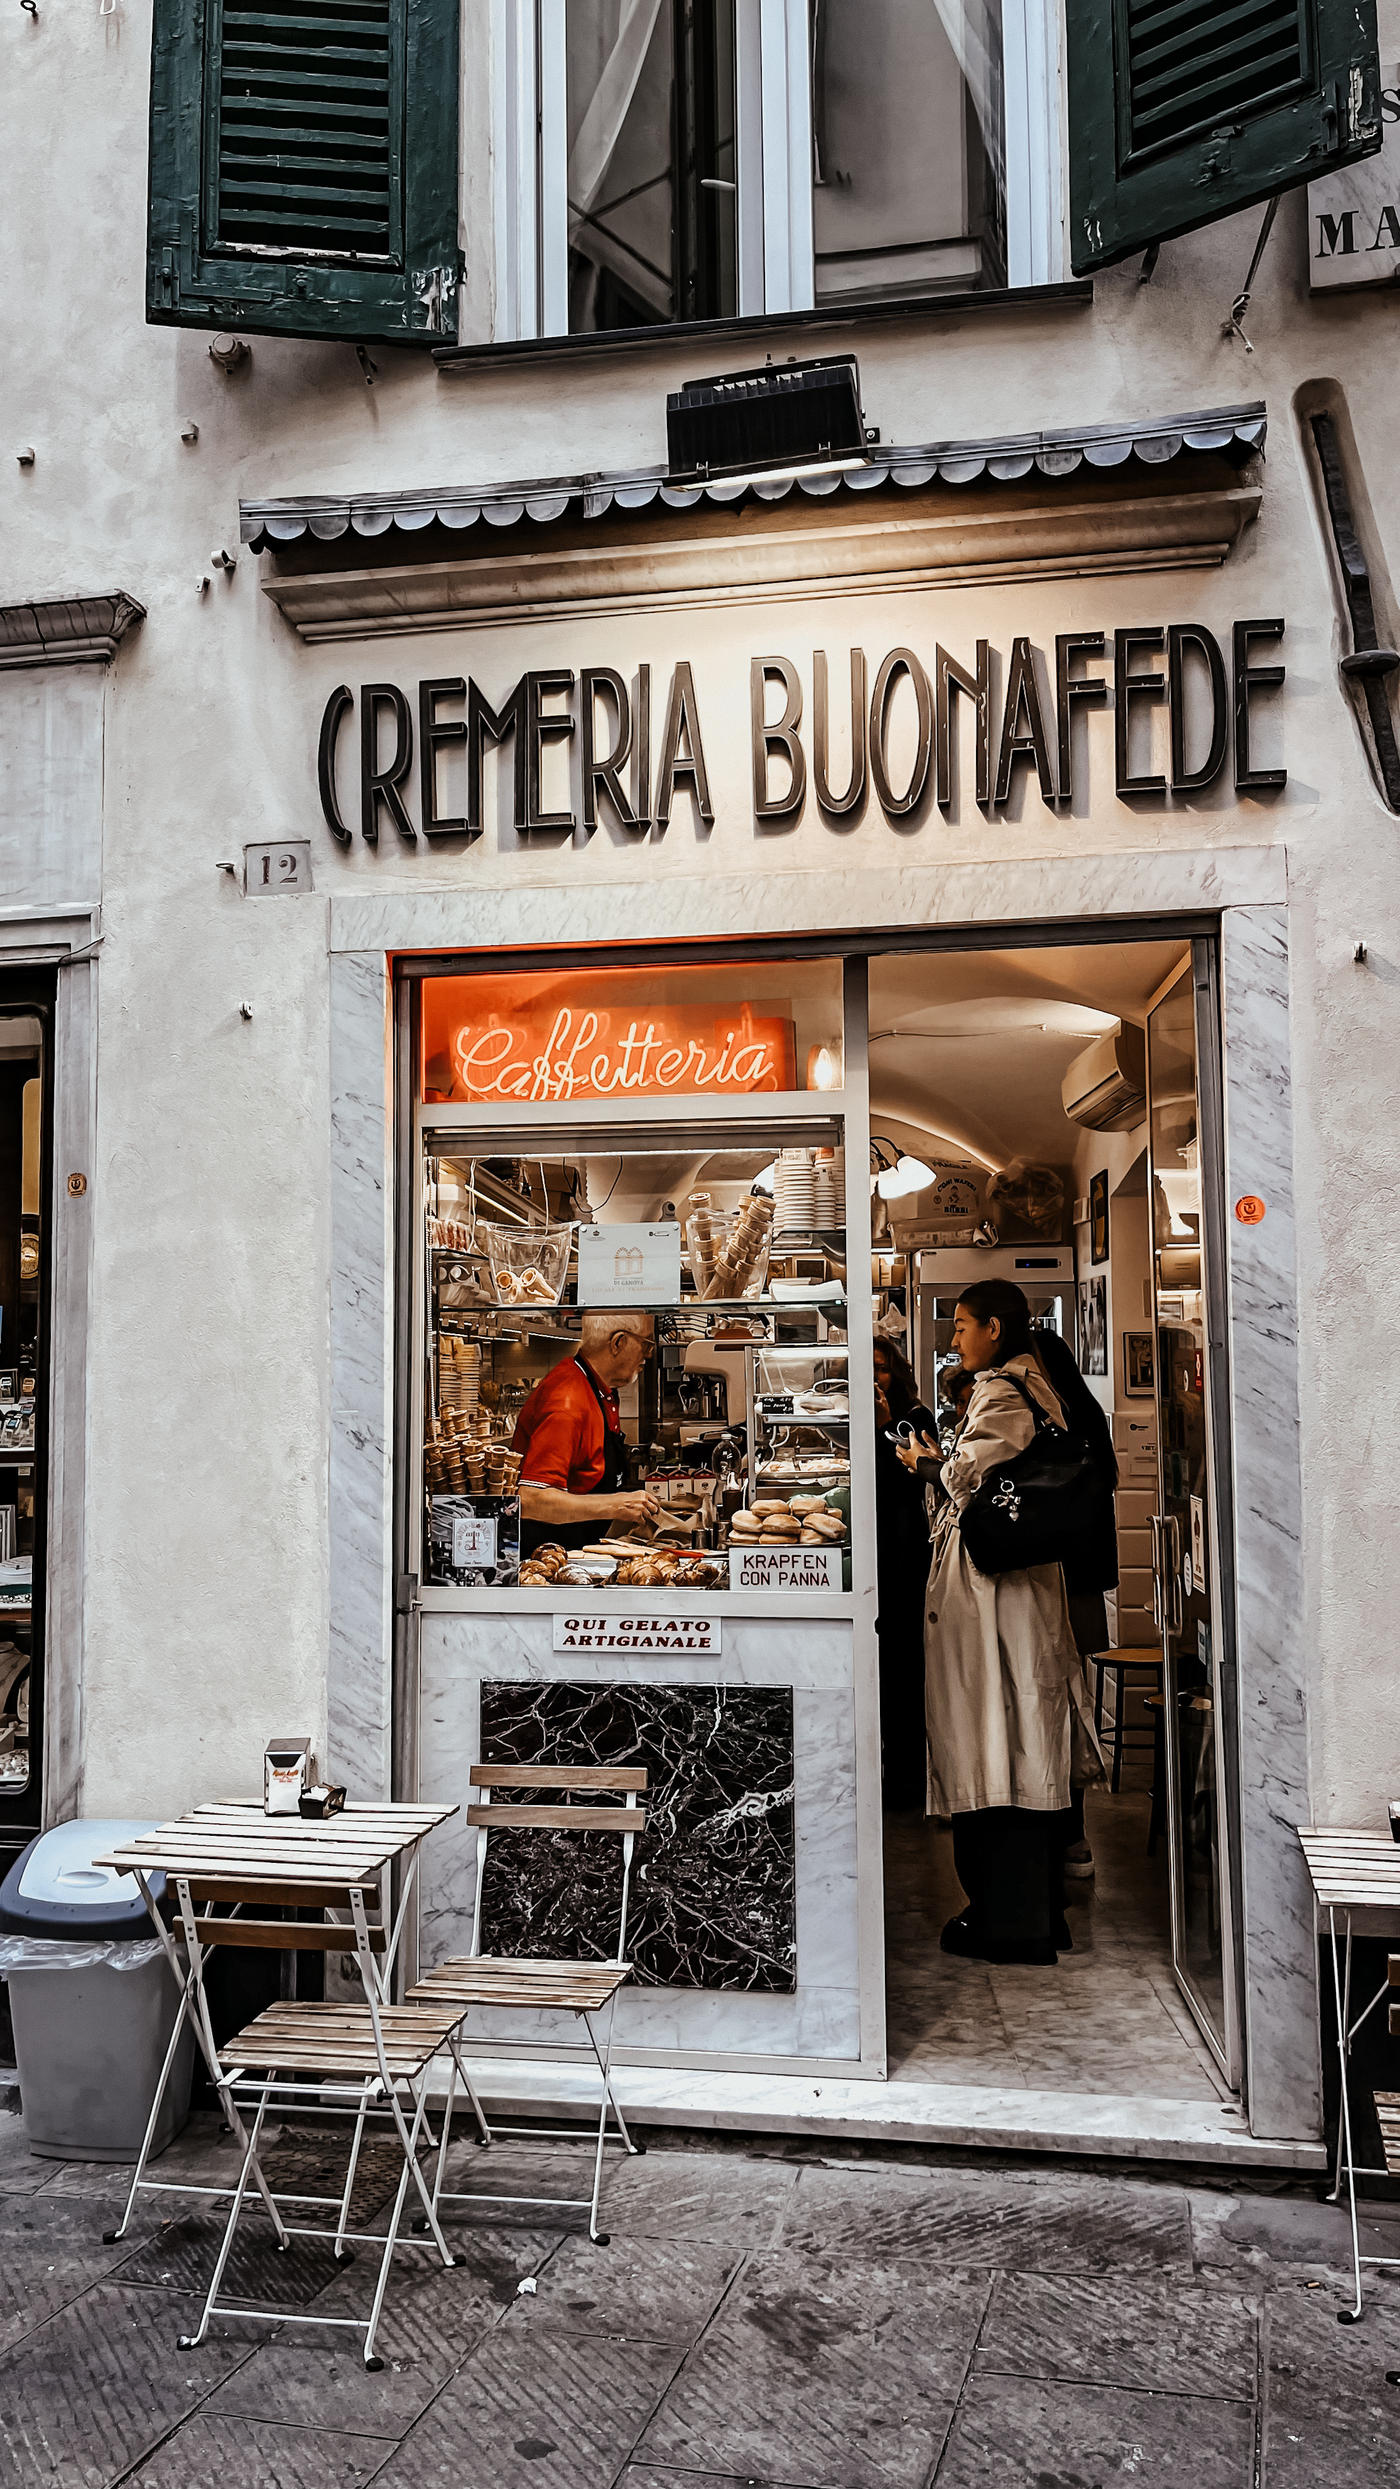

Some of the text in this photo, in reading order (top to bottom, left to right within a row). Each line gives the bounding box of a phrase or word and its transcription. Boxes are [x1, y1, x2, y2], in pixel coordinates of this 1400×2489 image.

[1314, 205, 1400, 258] MA
[318, 618, 1287, 843] CREMERIA BUONAFEDE
[259, 854, 298, 886] 12
[457, 1008, 775, 1100] Caffetteria
[743, 1554, 827, 1569] KRAPFEN
[740, 1571, 830, 1587] CON PANNA
[564, 1619, 711, 1632] QUI GELATO
[562, 1635, 712, 1648] ARTIGIANALE
